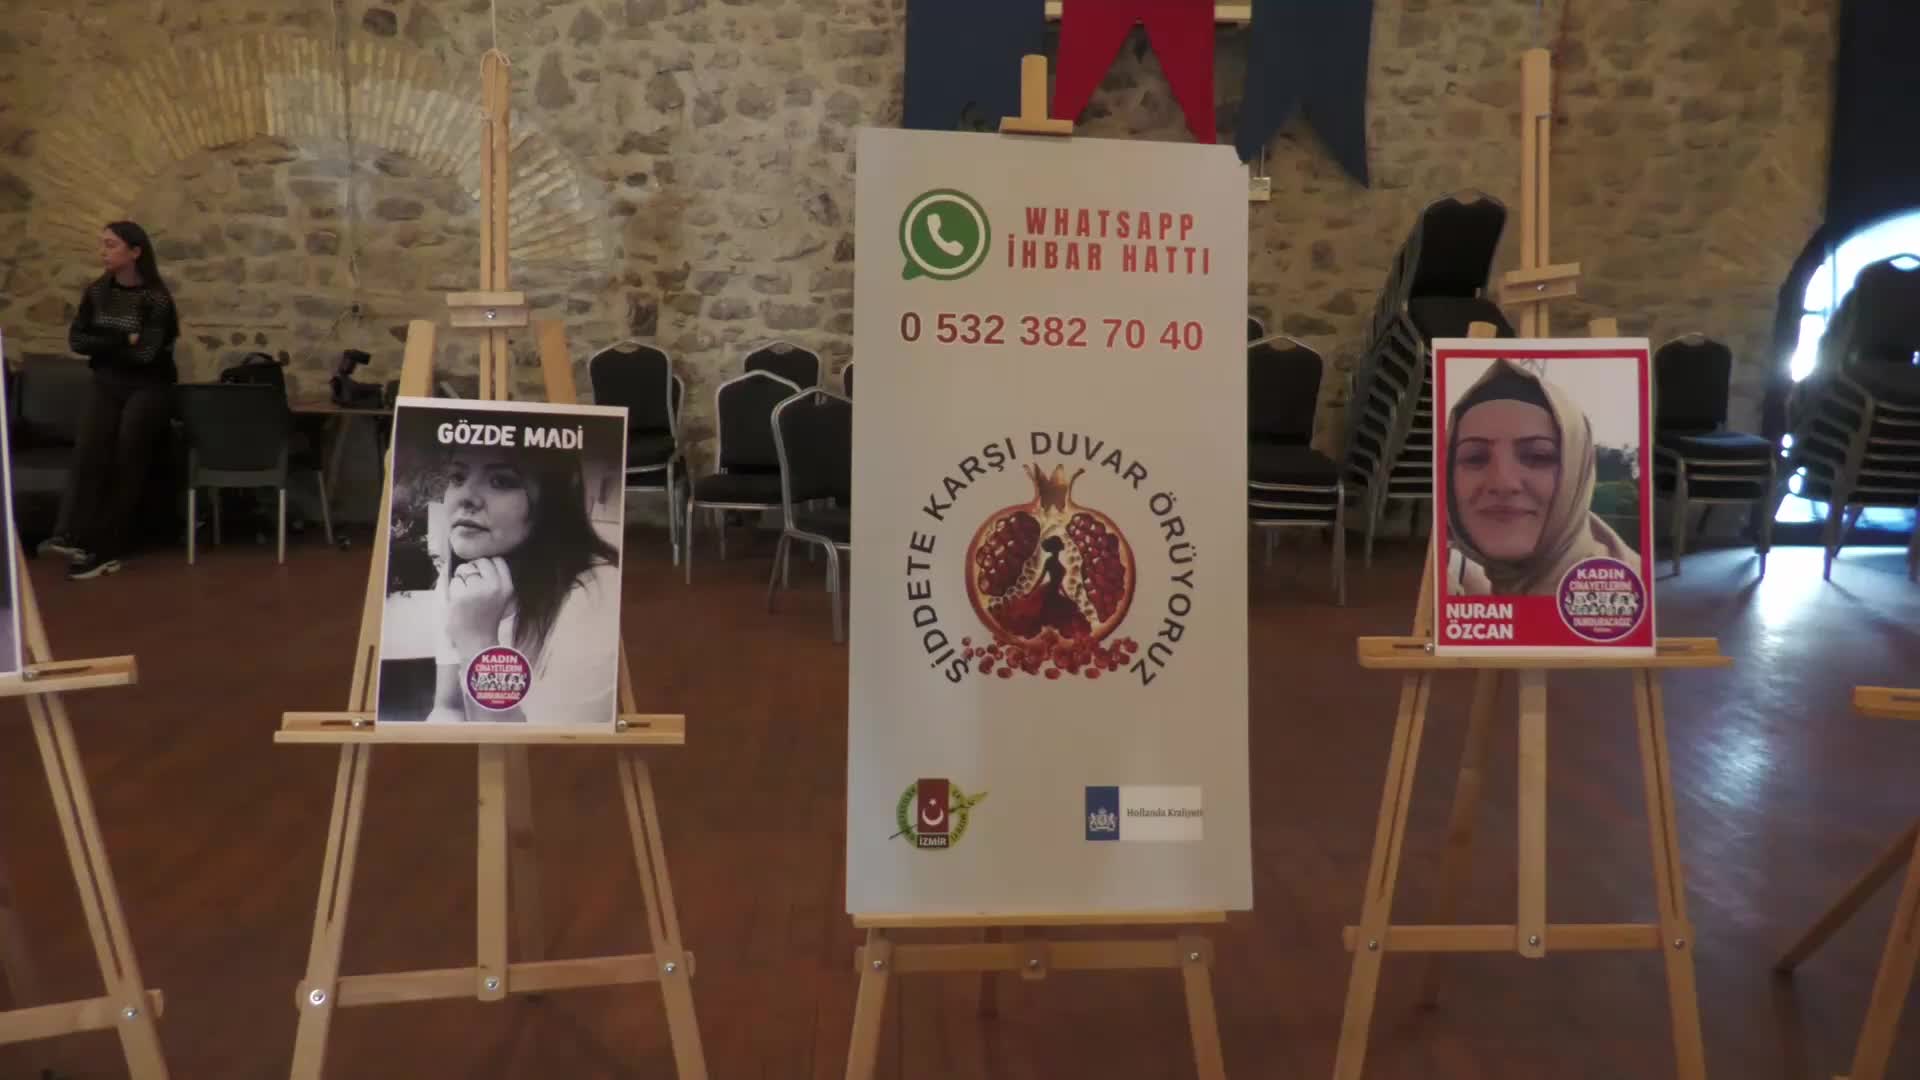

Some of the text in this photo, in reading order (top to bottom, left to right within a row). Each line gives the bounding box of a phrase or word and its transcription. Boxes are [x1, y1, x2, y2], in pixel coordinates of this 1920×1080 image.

[1025, 207, 1195, 241] WHATSAPP
[1007, 233, 1210, 276] İHBAR HATTI
[900, 311, 1204, 351] 0 532 382 70 40
[437, 419, 583, 449] GÖZDE MADİ
[907, 431, 1197, 686] ŞİDDETE KARŞI DUVAR ÖRÜYORUZ
[1576, 568, 1625, 580] KADIN
[1446, 603, 1513, 619] NURAN
[1446, 619, 1514, 640] ÖZCAN
[481, 654, 518, 664] KADIN
[1127, 807, 1166, 817] Hollanda
[919, 835, 947, 846] İZMİR
